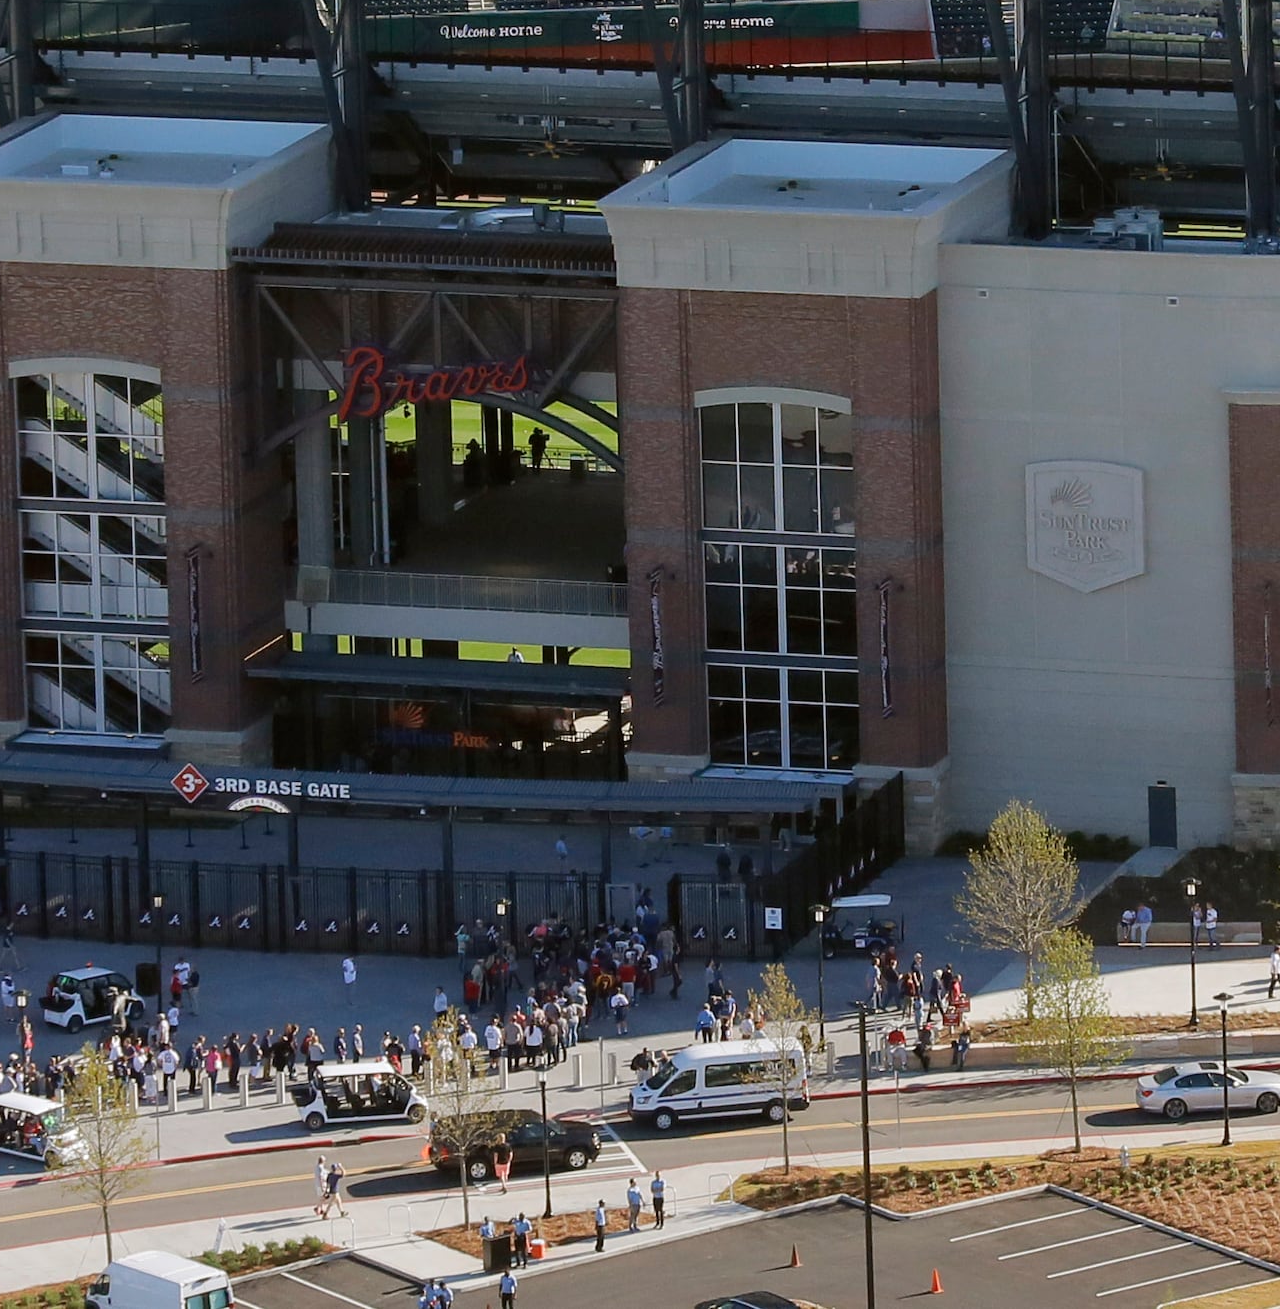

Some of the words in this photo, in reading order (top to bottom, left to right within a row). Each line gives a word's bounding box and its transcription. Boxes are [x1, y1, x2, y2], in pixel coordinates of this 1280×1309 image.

[440, 24, 496, 40] Welcome
[338, 346, 529, 422] Braves
[215, 778, 251, 794] 3RD
[256, 780, 302, 795] BASE
[307, 783, 351, 799] GATE
